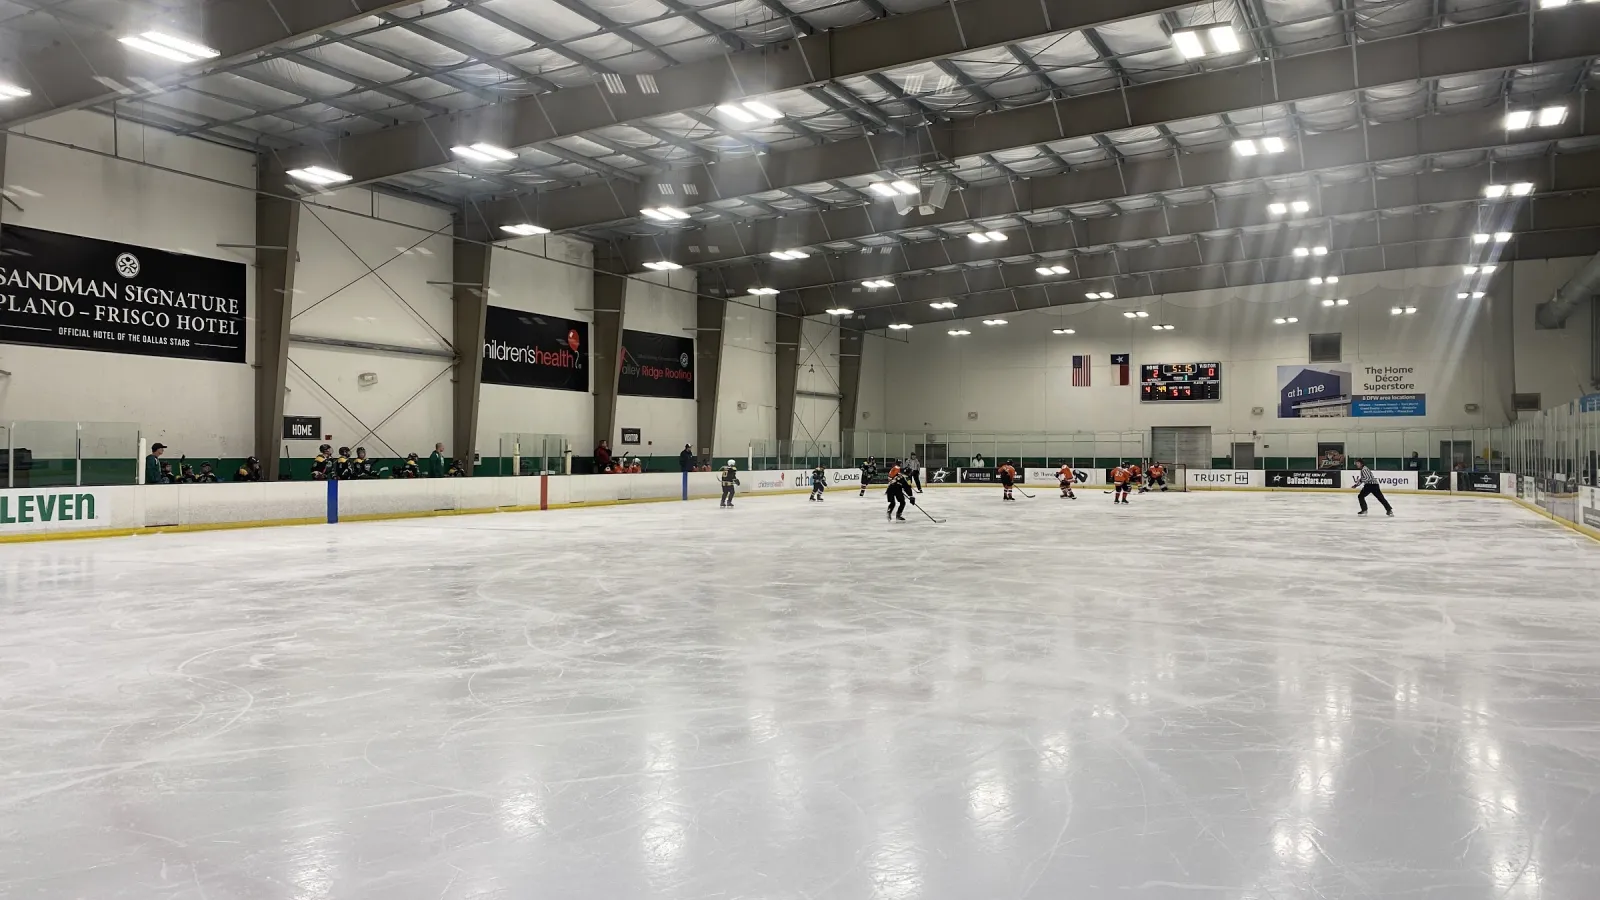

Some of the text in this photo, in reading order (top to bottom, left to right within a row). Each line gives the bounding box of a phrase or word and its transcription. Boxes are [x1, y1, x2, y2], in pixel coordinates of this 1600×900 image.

[0, 267, 239, 315] SANDMAN SIGNATURE
[94, 305, 170, 328] FRISCO
[176, 315, 239, 335] HOTEL
[58, 327, 90, 338] OFFICIAL
[93, 330, 115, 340] HOTEL
[128, 333, 140, 342] THE
[142, 335, 168, 345] DALLAS
[169, 338, 190, 346] STARS
[482, 339, 574, 368] hildren'shealth
[641, 365, 664, 379] Ridge
[665, 368, 692, 382] Roofing
[1153, 368, 1215, 378] 2 0
[1365, 366, 1413, 374] The Home
[1375, 374, 1403, 383] Décor
[1363, 383, 1415, 391] Superstore
[1287, 389, 1296, 398] at
[292, 424, 313, 436] HOME
[795, 474, 803, 487] at
[1193, 473, 1232, 482] TRUIST
[1352, 475, 1409, 486] Vwagen
